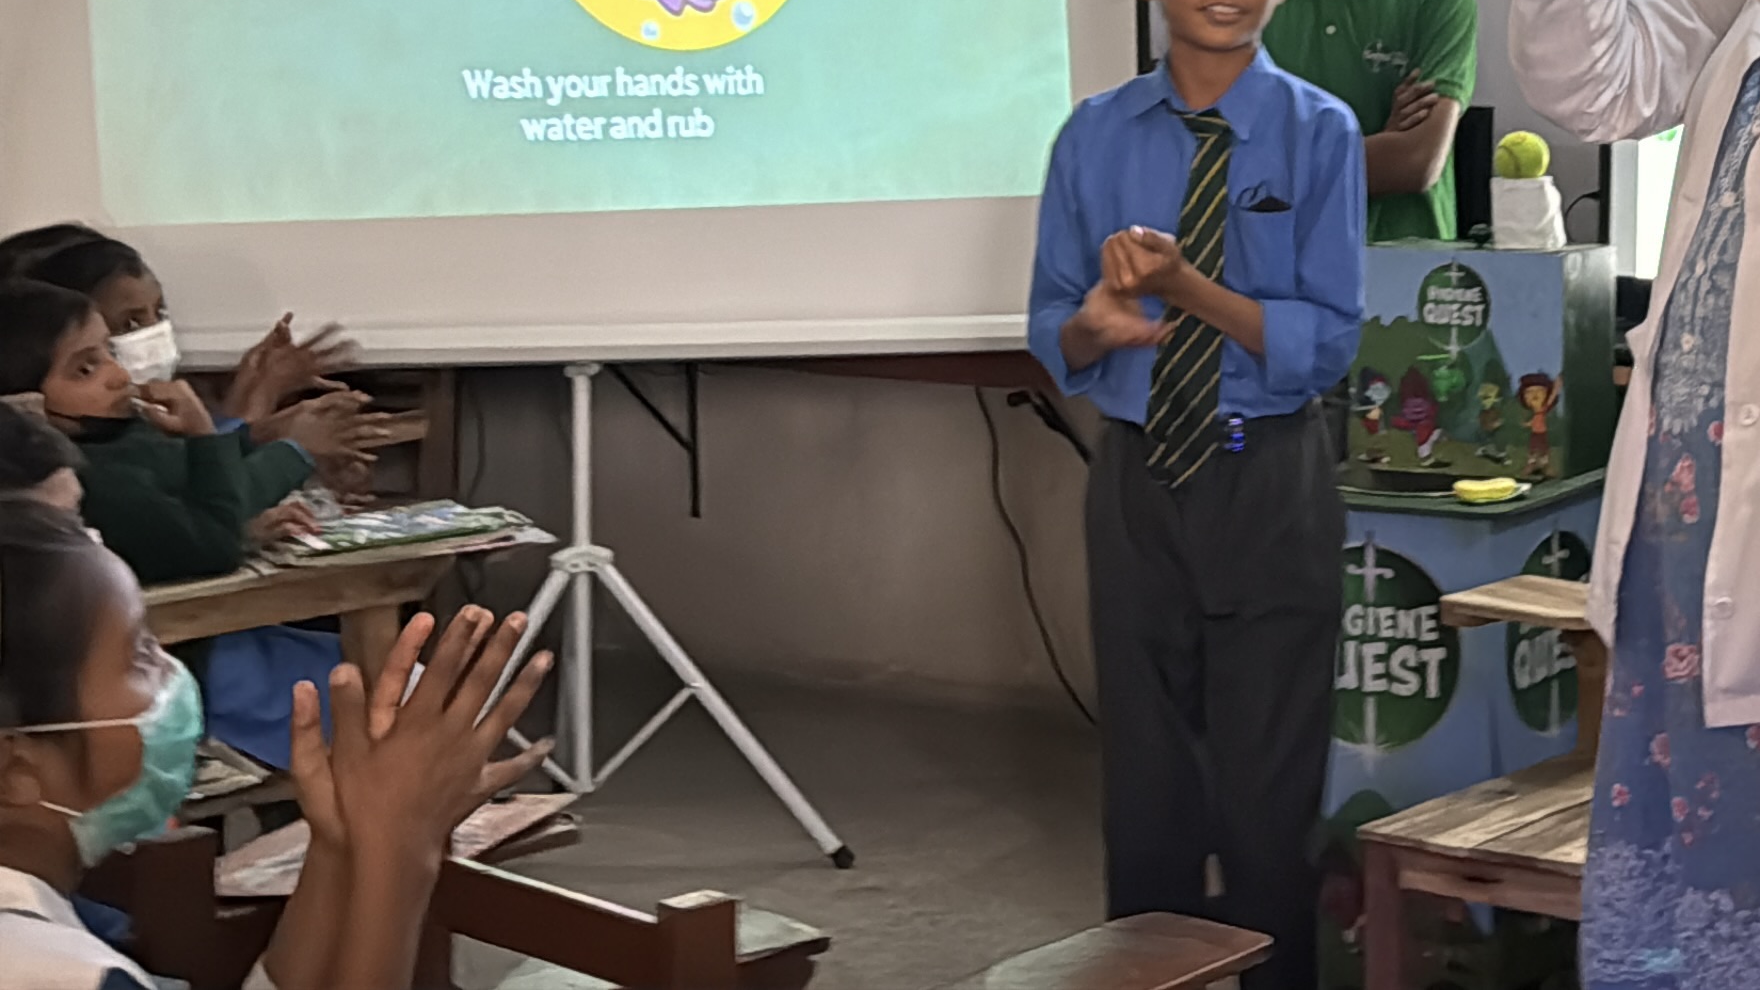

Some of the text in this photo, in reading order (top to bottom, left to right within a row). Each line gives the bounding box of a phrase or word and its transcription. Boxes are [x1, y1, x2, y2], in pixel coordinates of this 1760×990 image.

[461, 64, 765, 107] Wash your hands with
[520, 107, 715, 142] water and rub
[1423, 302, 1486, 326] QUEST
[1342, 604, 1439, 641] GIENE
[1334, 640, 1448, 698] UEST
